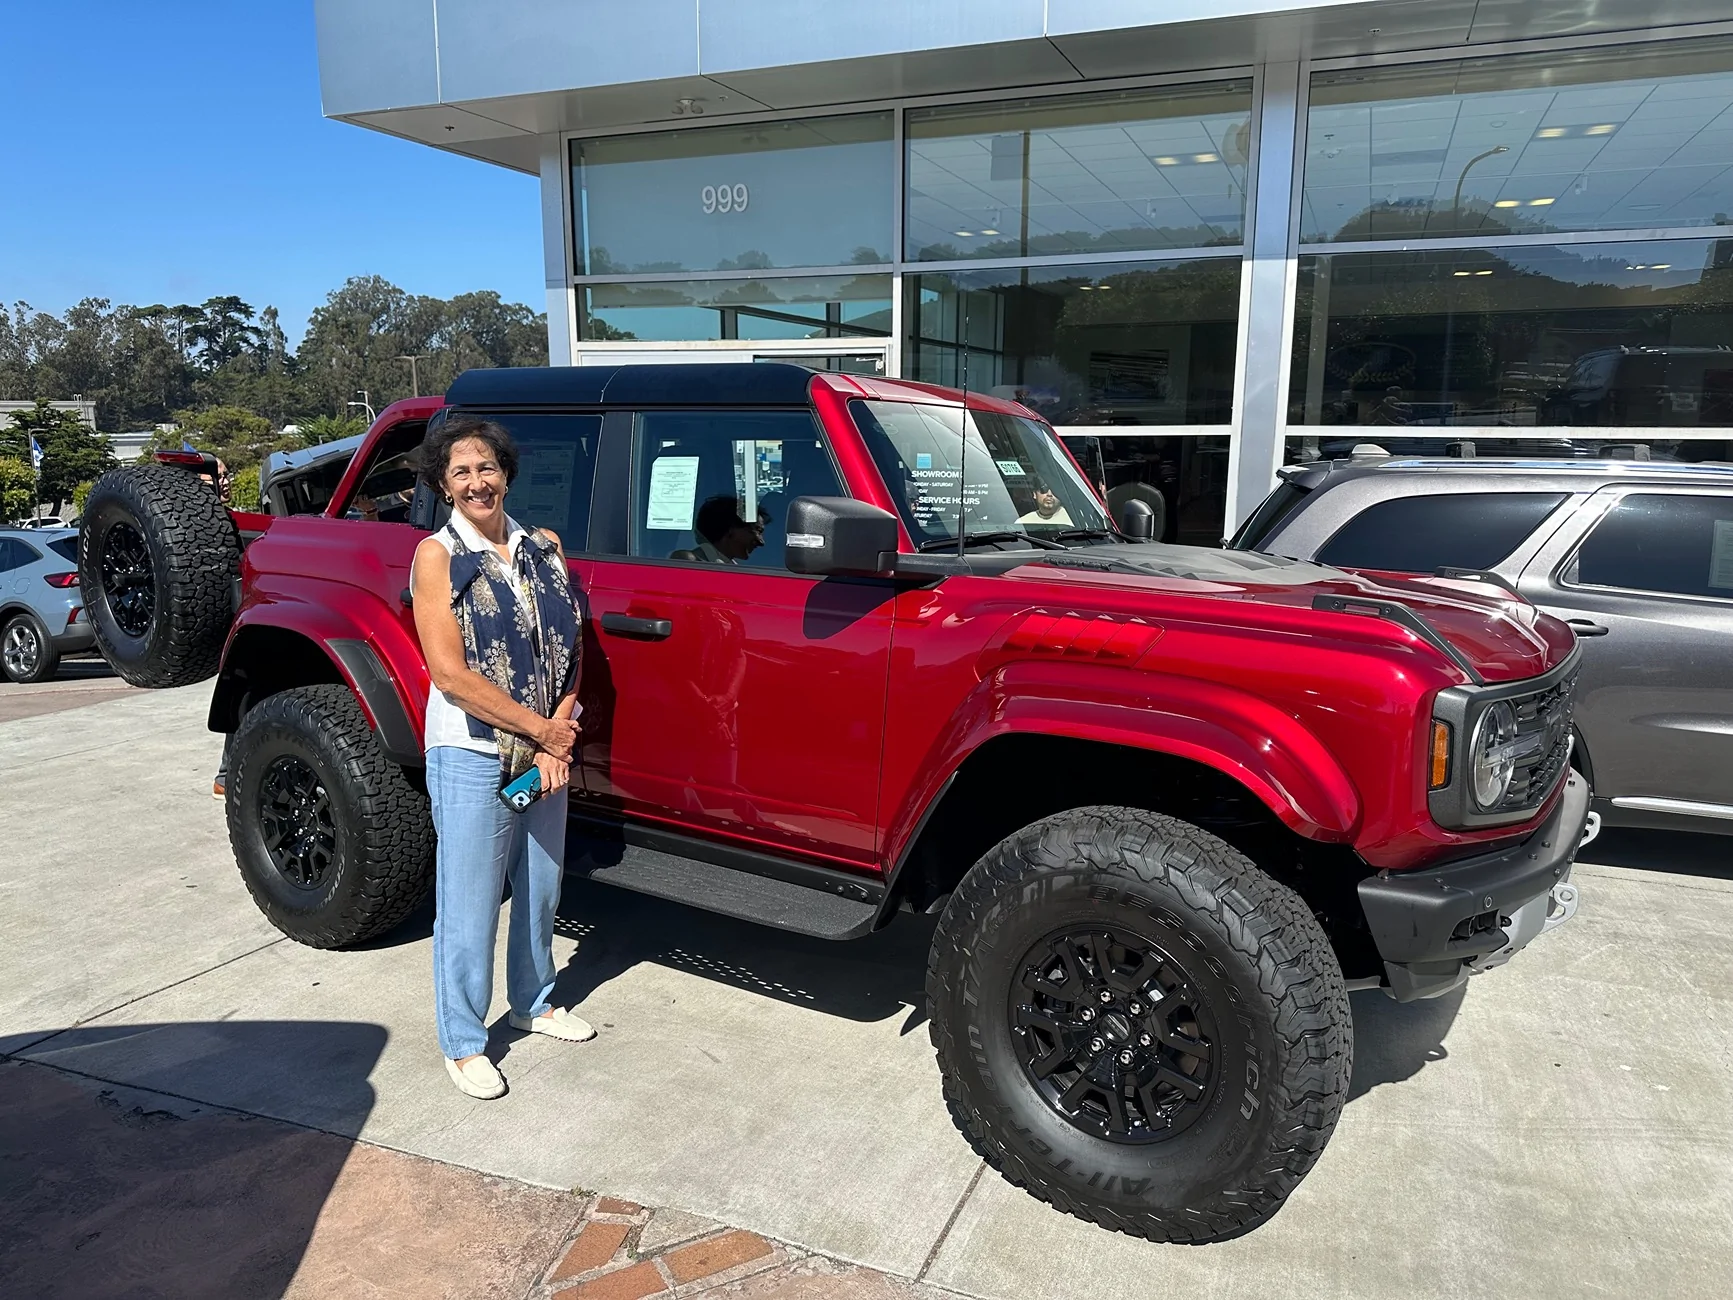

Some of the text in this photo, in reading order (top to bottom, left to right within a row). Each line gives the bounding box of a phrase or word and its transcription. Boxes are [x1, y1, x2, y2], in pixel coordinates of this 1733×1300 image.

[701, 183, 749, 214] 999
[911, 470, 959, 478] SHOWROOM
[918, 496, 951, 504] SERVICE
[1088, 884, 1261, 1121] BFGoodrich
[967, 1024, 1153, 1197] All-Terrain
